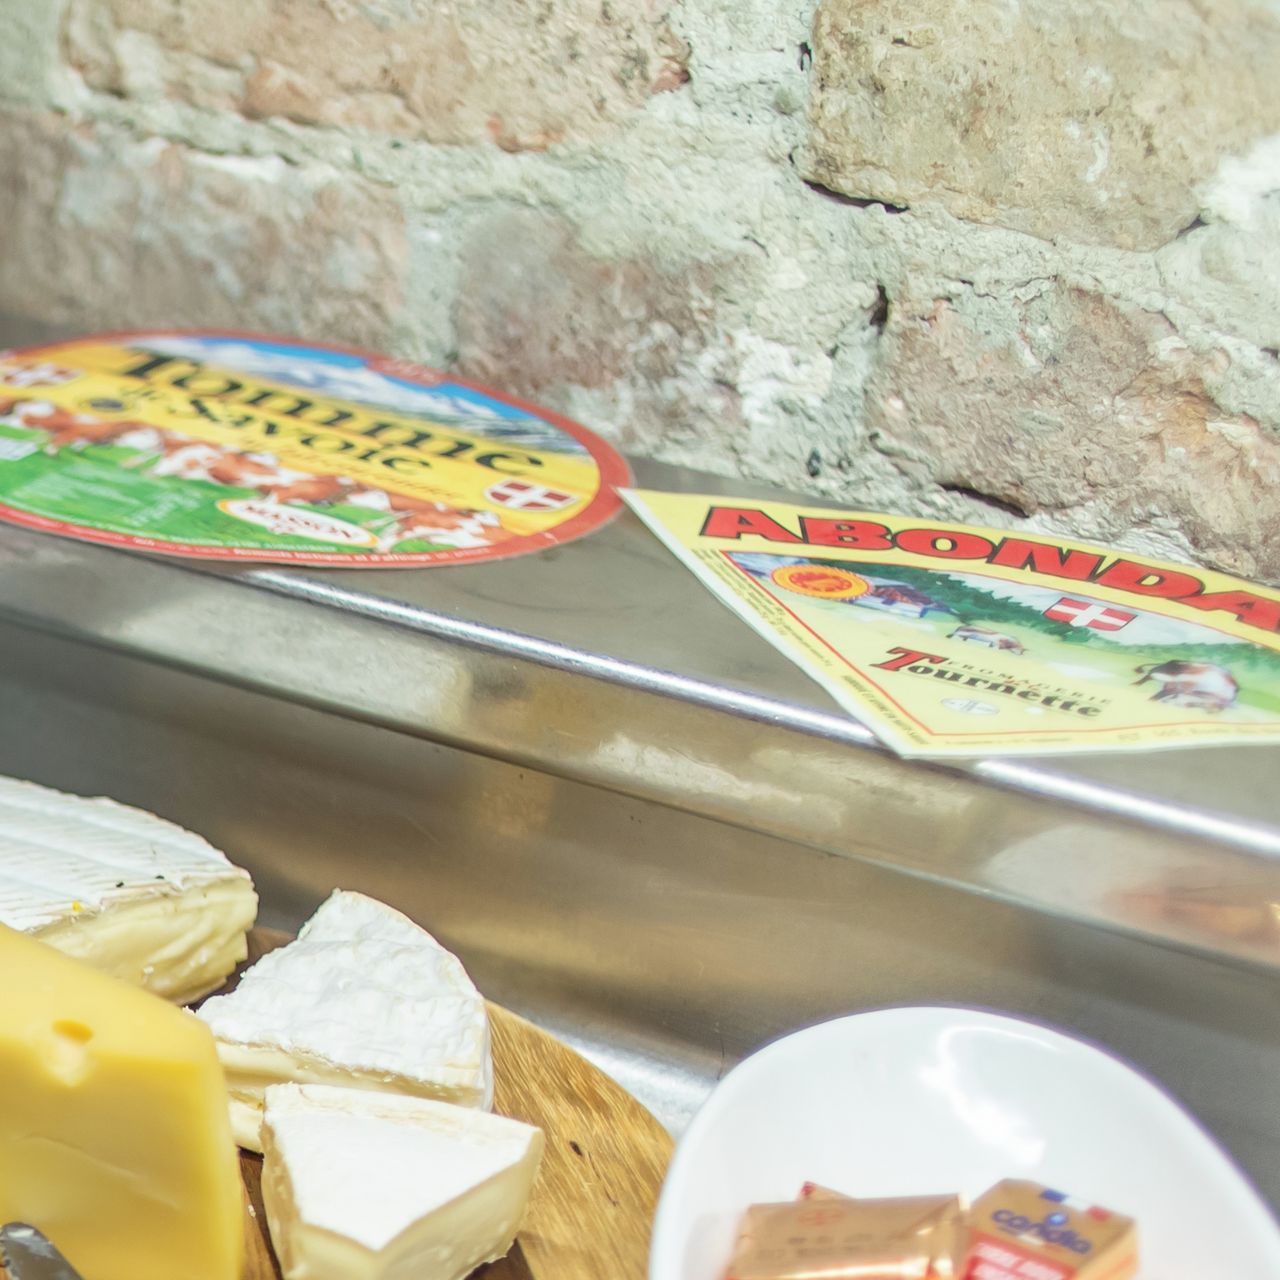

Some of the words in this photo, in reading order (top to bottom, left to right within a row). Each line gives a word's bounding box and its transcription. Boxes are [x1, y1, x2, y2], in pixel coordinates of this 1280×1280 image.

[120, 352, 546, 476] Tomme
[166, 398, 430, 475] Savoie
[868, 646, 1103, 717] Tournette
